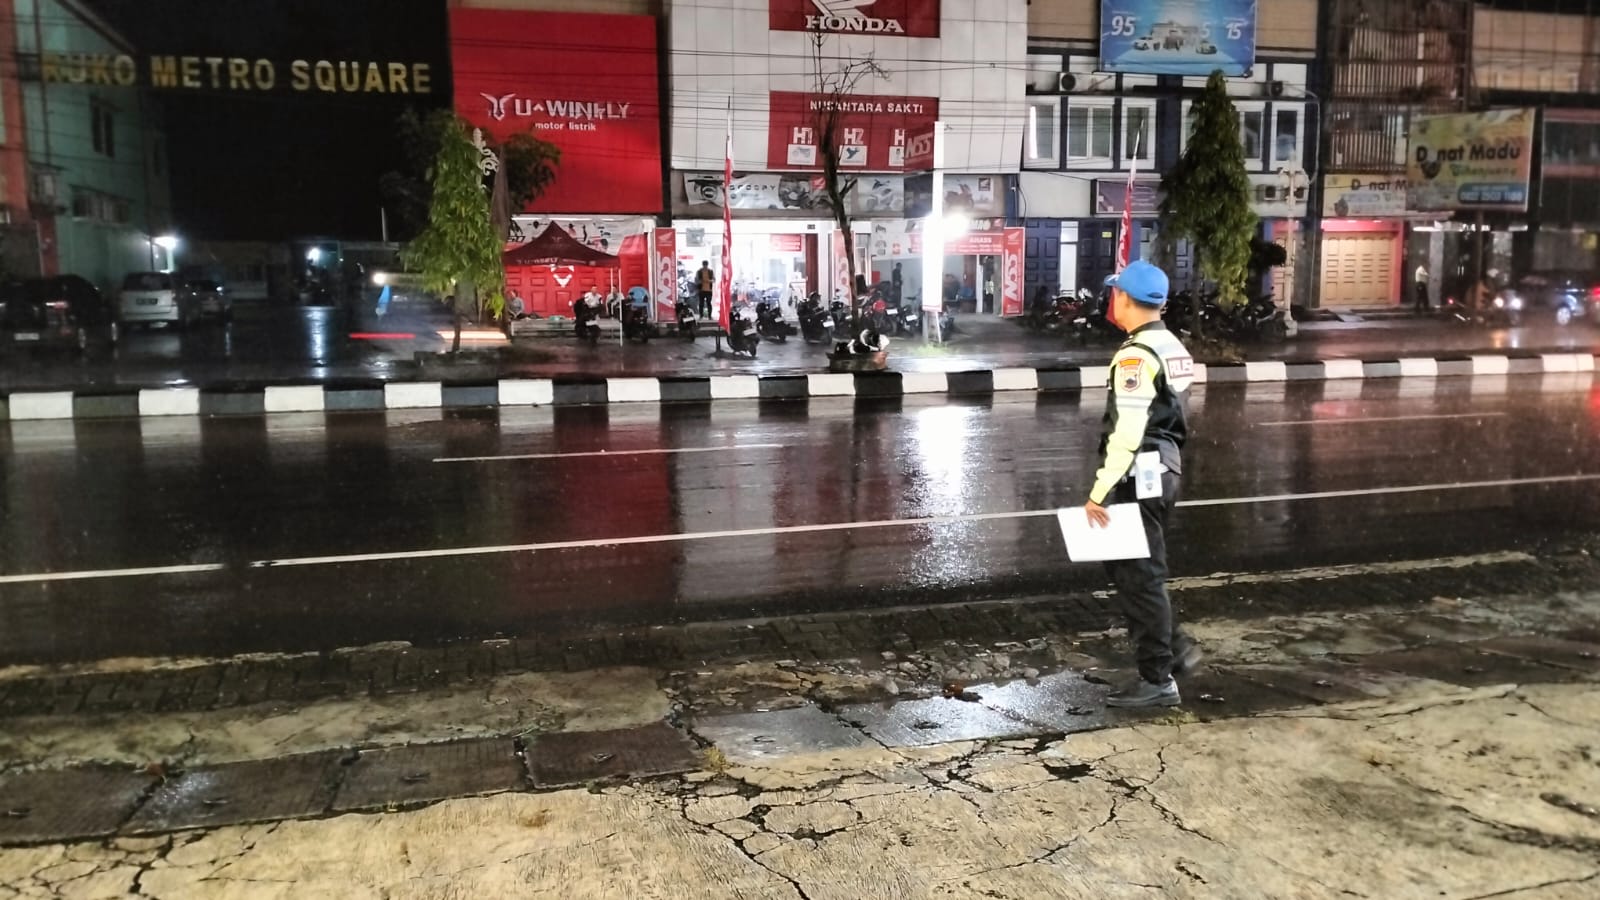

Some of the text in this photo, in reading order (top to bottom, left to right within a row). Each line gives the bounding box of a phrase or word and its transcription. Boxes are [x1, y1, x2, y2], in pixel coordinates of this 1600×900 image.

[805, 15, 905, 33] HONDA
[1111, 16, 1136, 36] 95
[1225, 22, 1243, 40] 15
[41, 54, 431, 94] RUKO METRO SQUARE
[810, 101, 923, 114] NUSANTARA SAKTI
[535, 121, 596, 131] motor listrik
[793, 127, 813, 144] H1
[844, 127, 864, 145] H2
[894, 129, 905, 146] H
[906, 133, 933, 159] NSS
[1469, 142, 1521, 160] Madu
[1351, 179, 1391, 191] Dnat
[657, 251, 675, 308] NSS
[1004, 248, 1020, 301] NSS
